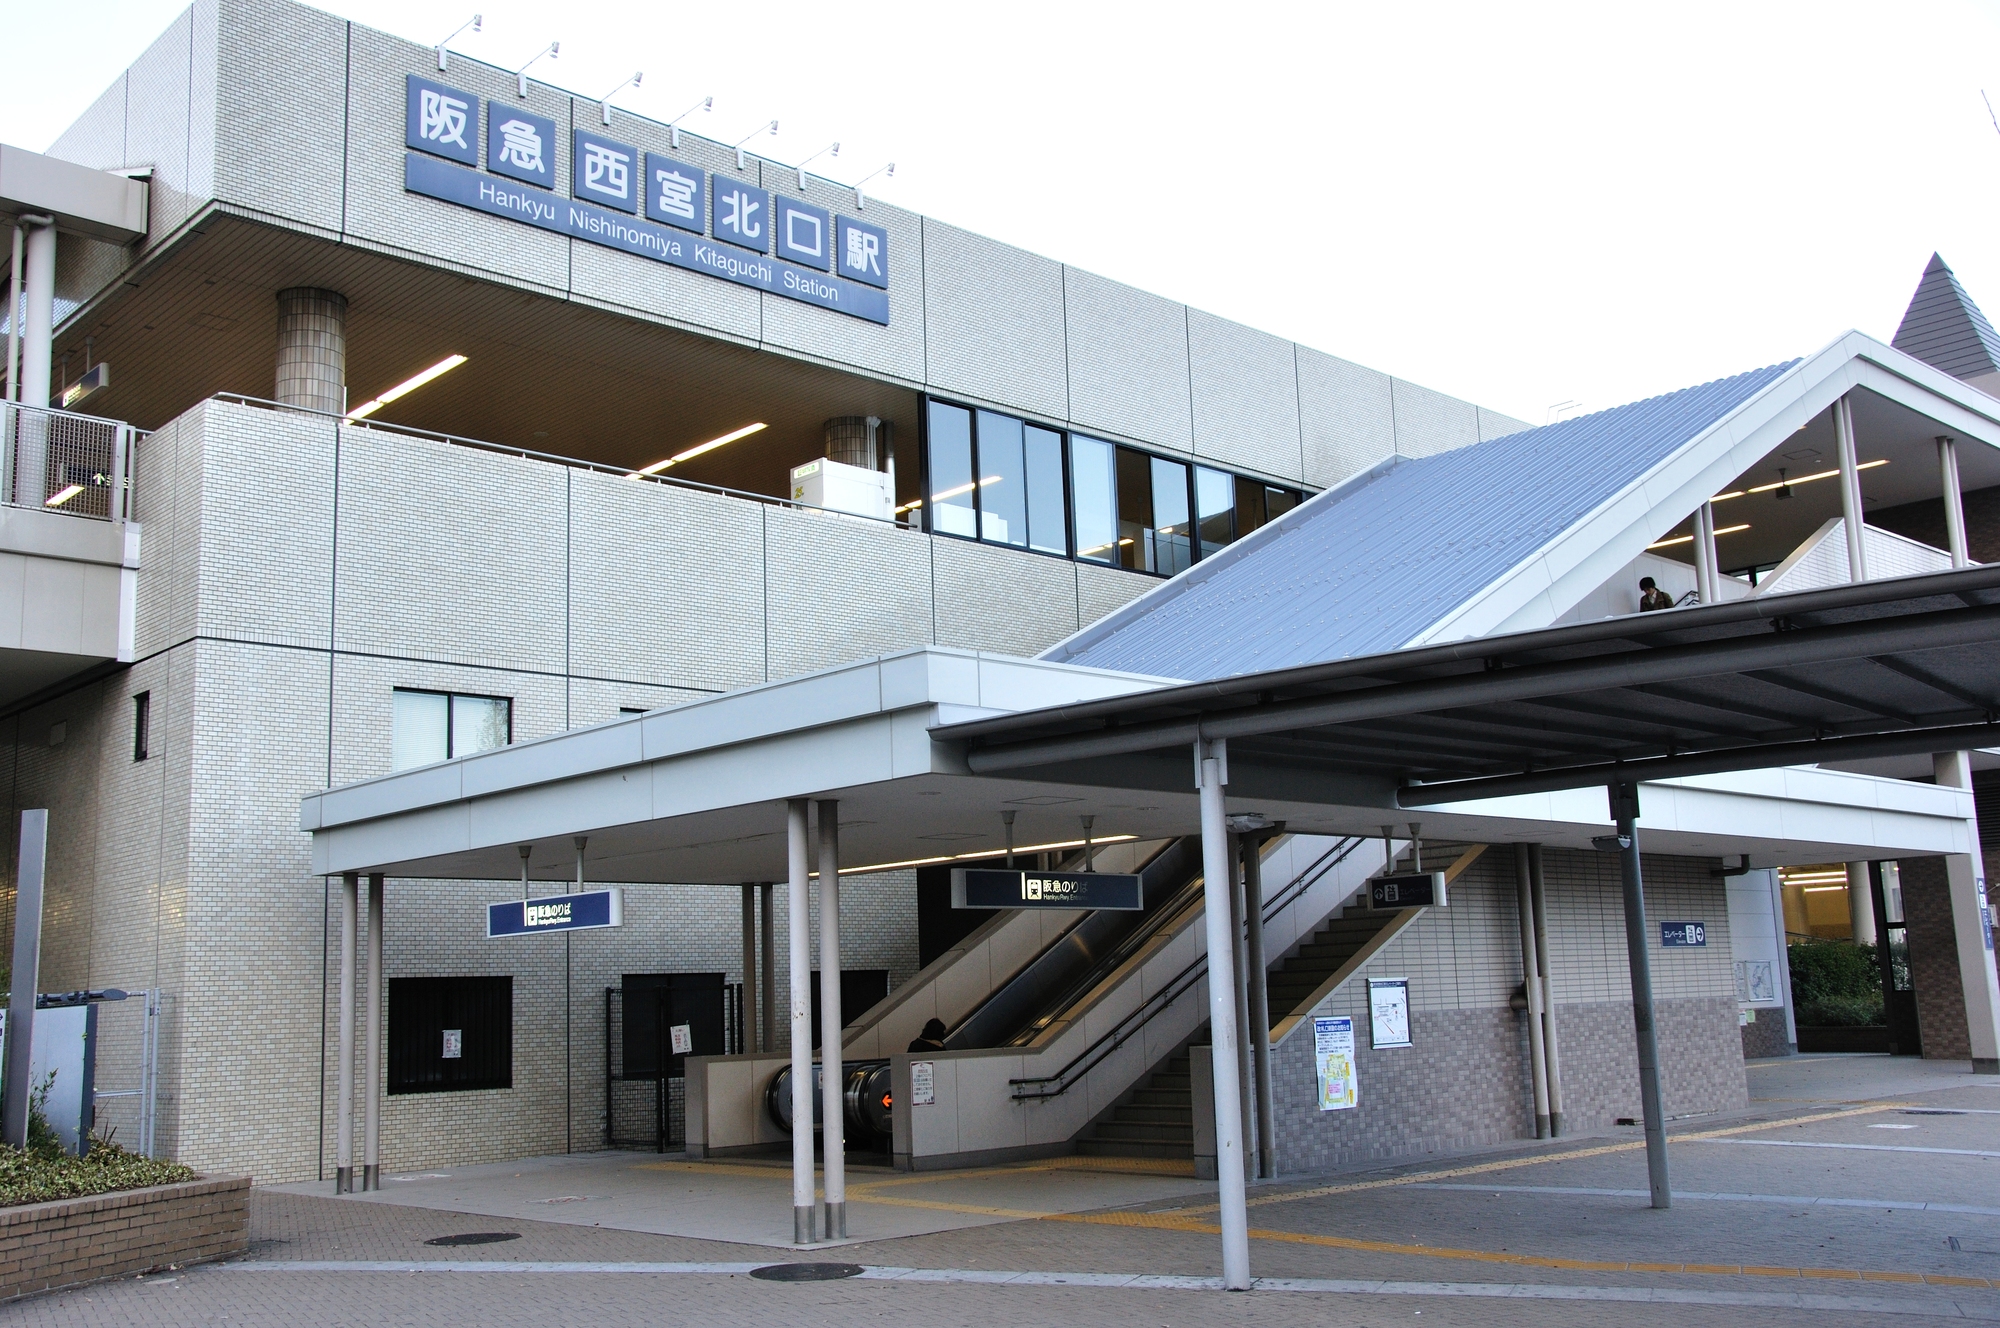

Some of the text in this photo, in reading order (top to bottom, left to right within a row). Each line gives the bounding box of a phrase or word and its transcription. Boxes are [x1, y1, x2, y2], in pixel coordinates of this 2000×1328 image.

[419, 88, 882, 277] 阪急西宮北口駅
[479, 181, 839, 302] Hankyu Nishinomiya Kitaguchi Station
[1043, 880, 1088, 893] 阪急のりば
[538, 902, 571, 917] 阪急のりば
[1664, 930, 1686, 938] エレベーター
